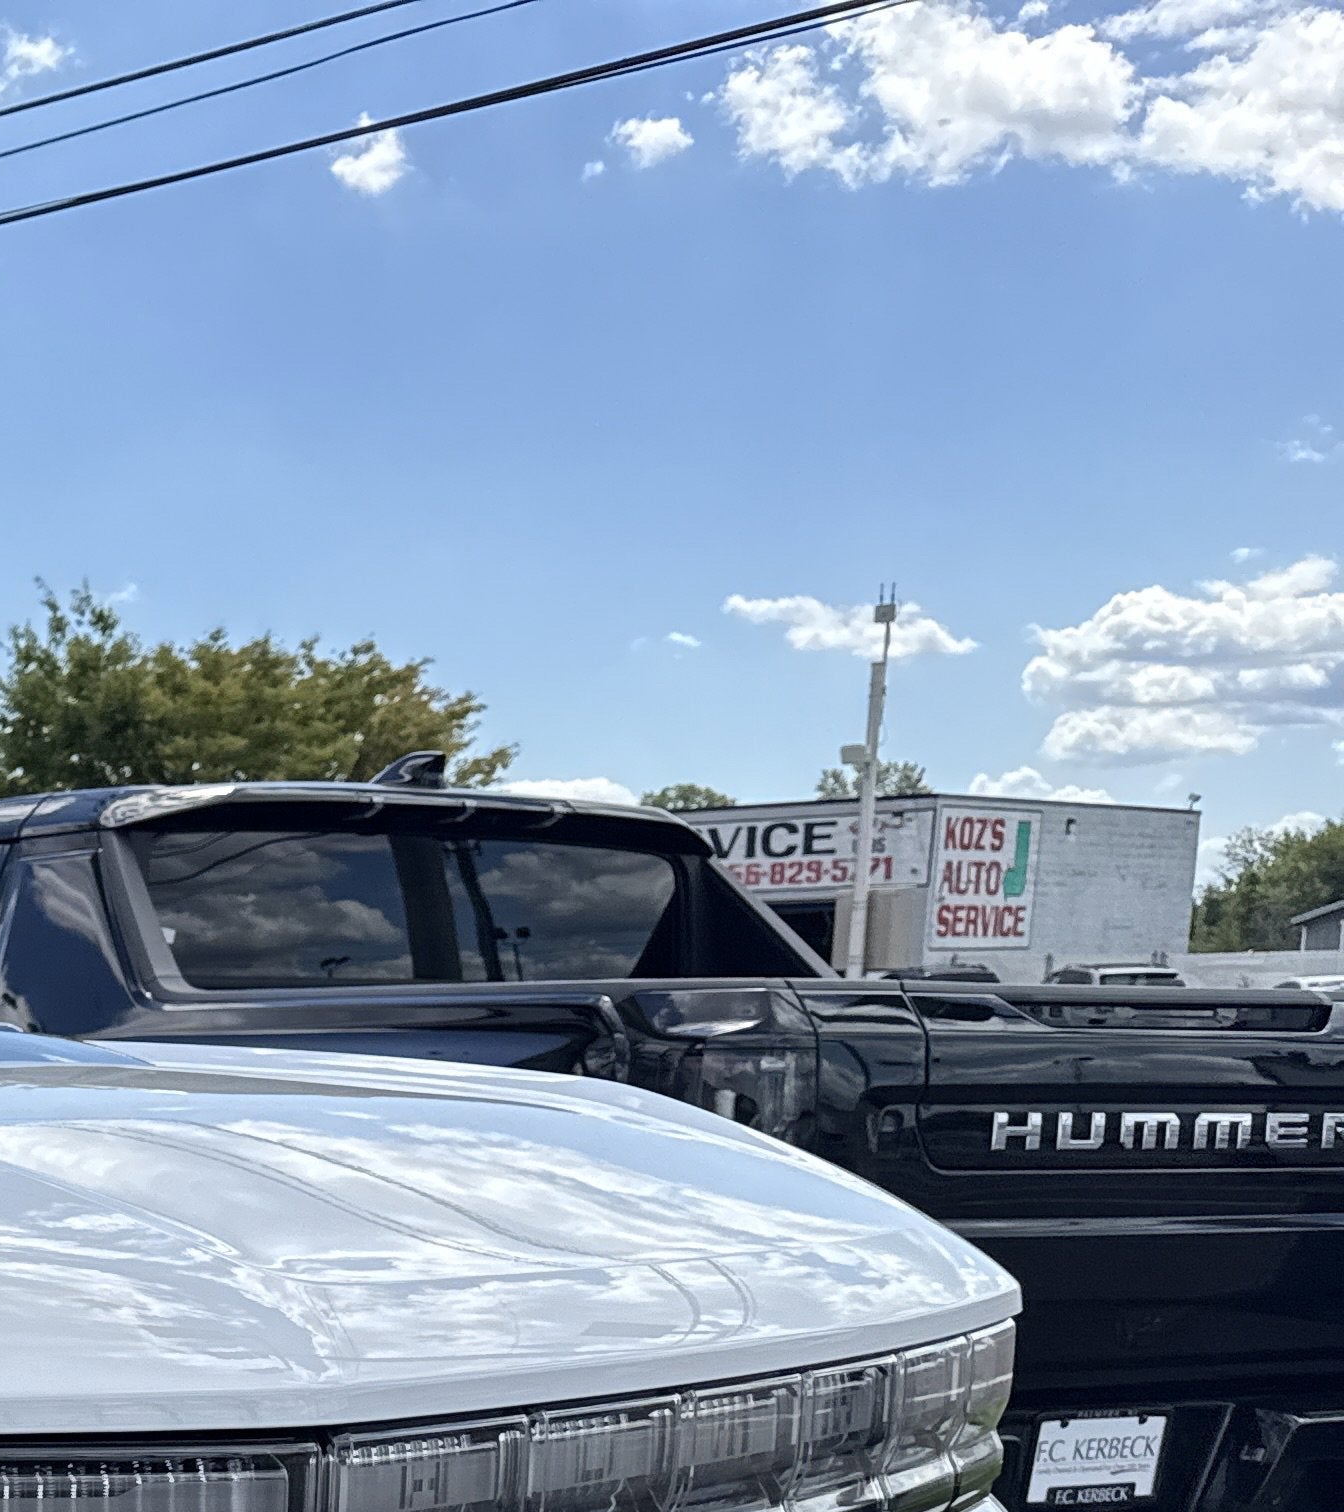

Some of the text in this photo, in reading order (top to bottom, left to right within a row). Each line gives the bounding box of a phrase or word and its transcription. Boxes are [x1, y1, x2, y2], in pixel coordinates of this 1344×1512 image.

[708, 820, 839, 860] VICE
[938, 859, 1003, 897] AUTO
[936, 904, 1027, 938] SERVICE
[1072, 1434, 1159, 1461] KERBECK
[1076, 1486, 1129, 1504] KERBECK
